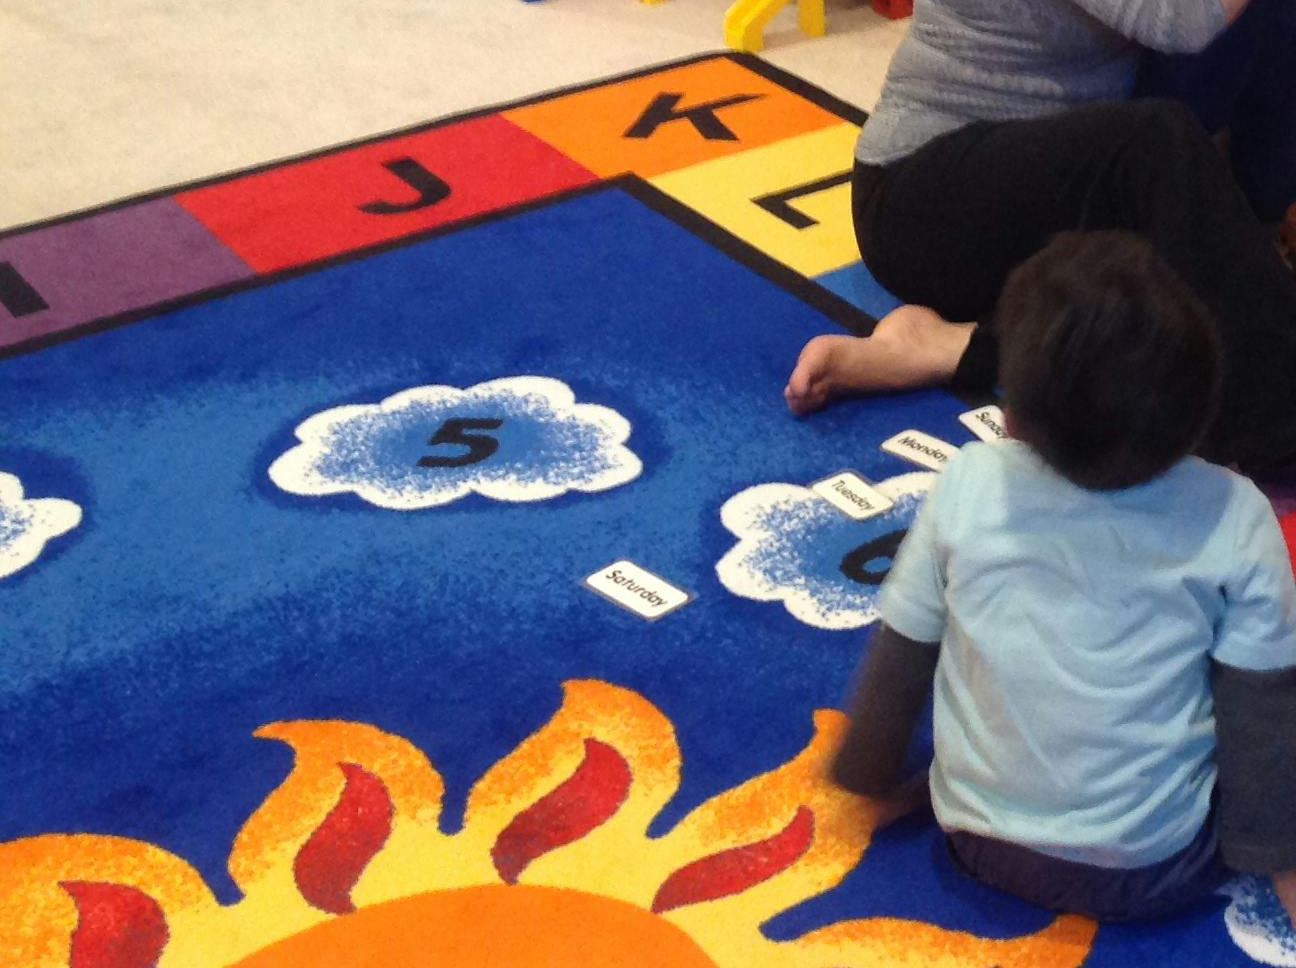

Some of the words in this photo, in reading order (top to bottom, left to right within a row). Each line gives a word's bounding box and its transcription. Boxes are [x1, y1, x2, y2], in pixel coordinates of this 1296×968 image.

[623, 93, 766, 141] K
[357, 157, 452, 215] J
[416, 417, 504, 468] 5
[897, 435, 949, 463] Monday
[831, 478, 875, 511] Tuesday
[605, 568, 668, 609] Saturday
